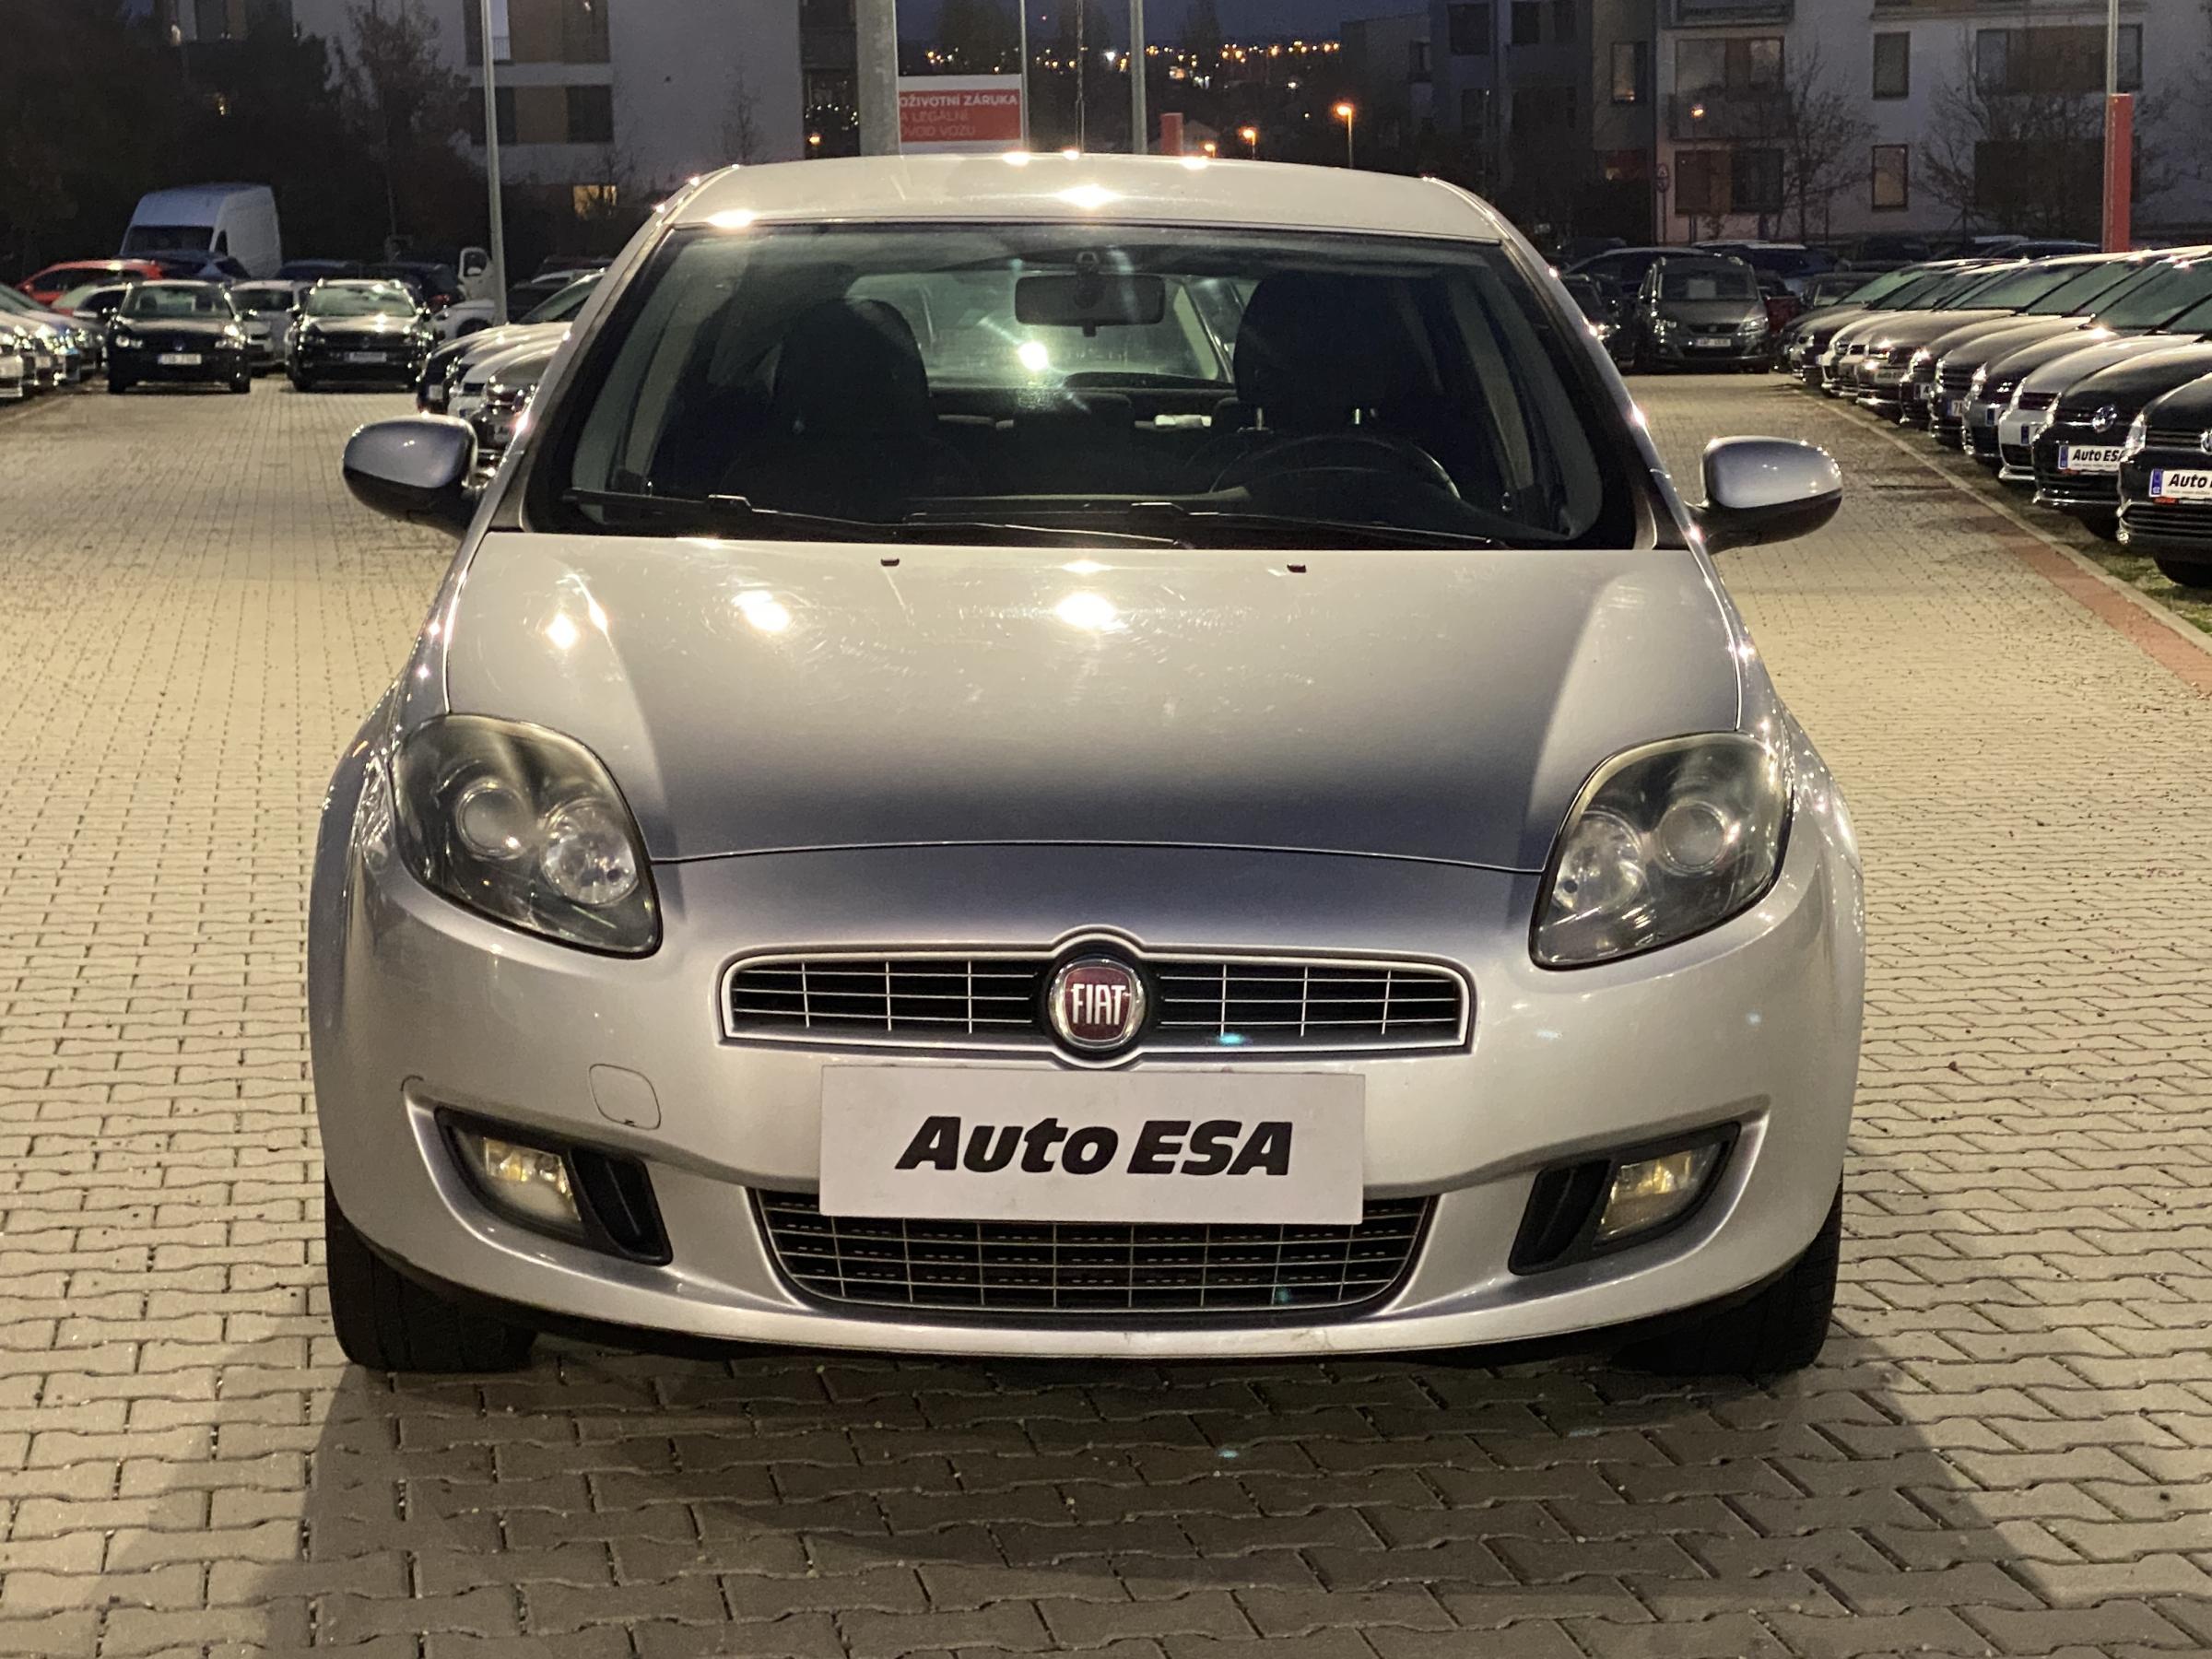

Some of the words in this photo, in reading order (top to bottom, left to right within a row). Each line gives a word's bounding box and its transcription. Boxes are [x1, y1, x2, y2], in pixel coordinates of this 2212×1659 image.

[964, 93, 1018, 107] ZÁRUKA
[2072, 449, 2102, 462] Auto
[2167, 473, 2208, 488] Auto
[1072, 982, 1126, 1026] FIAT
[895, 1116, 1119, 1175] Auto
[1126, 1121, 1293, 1176] ESA
